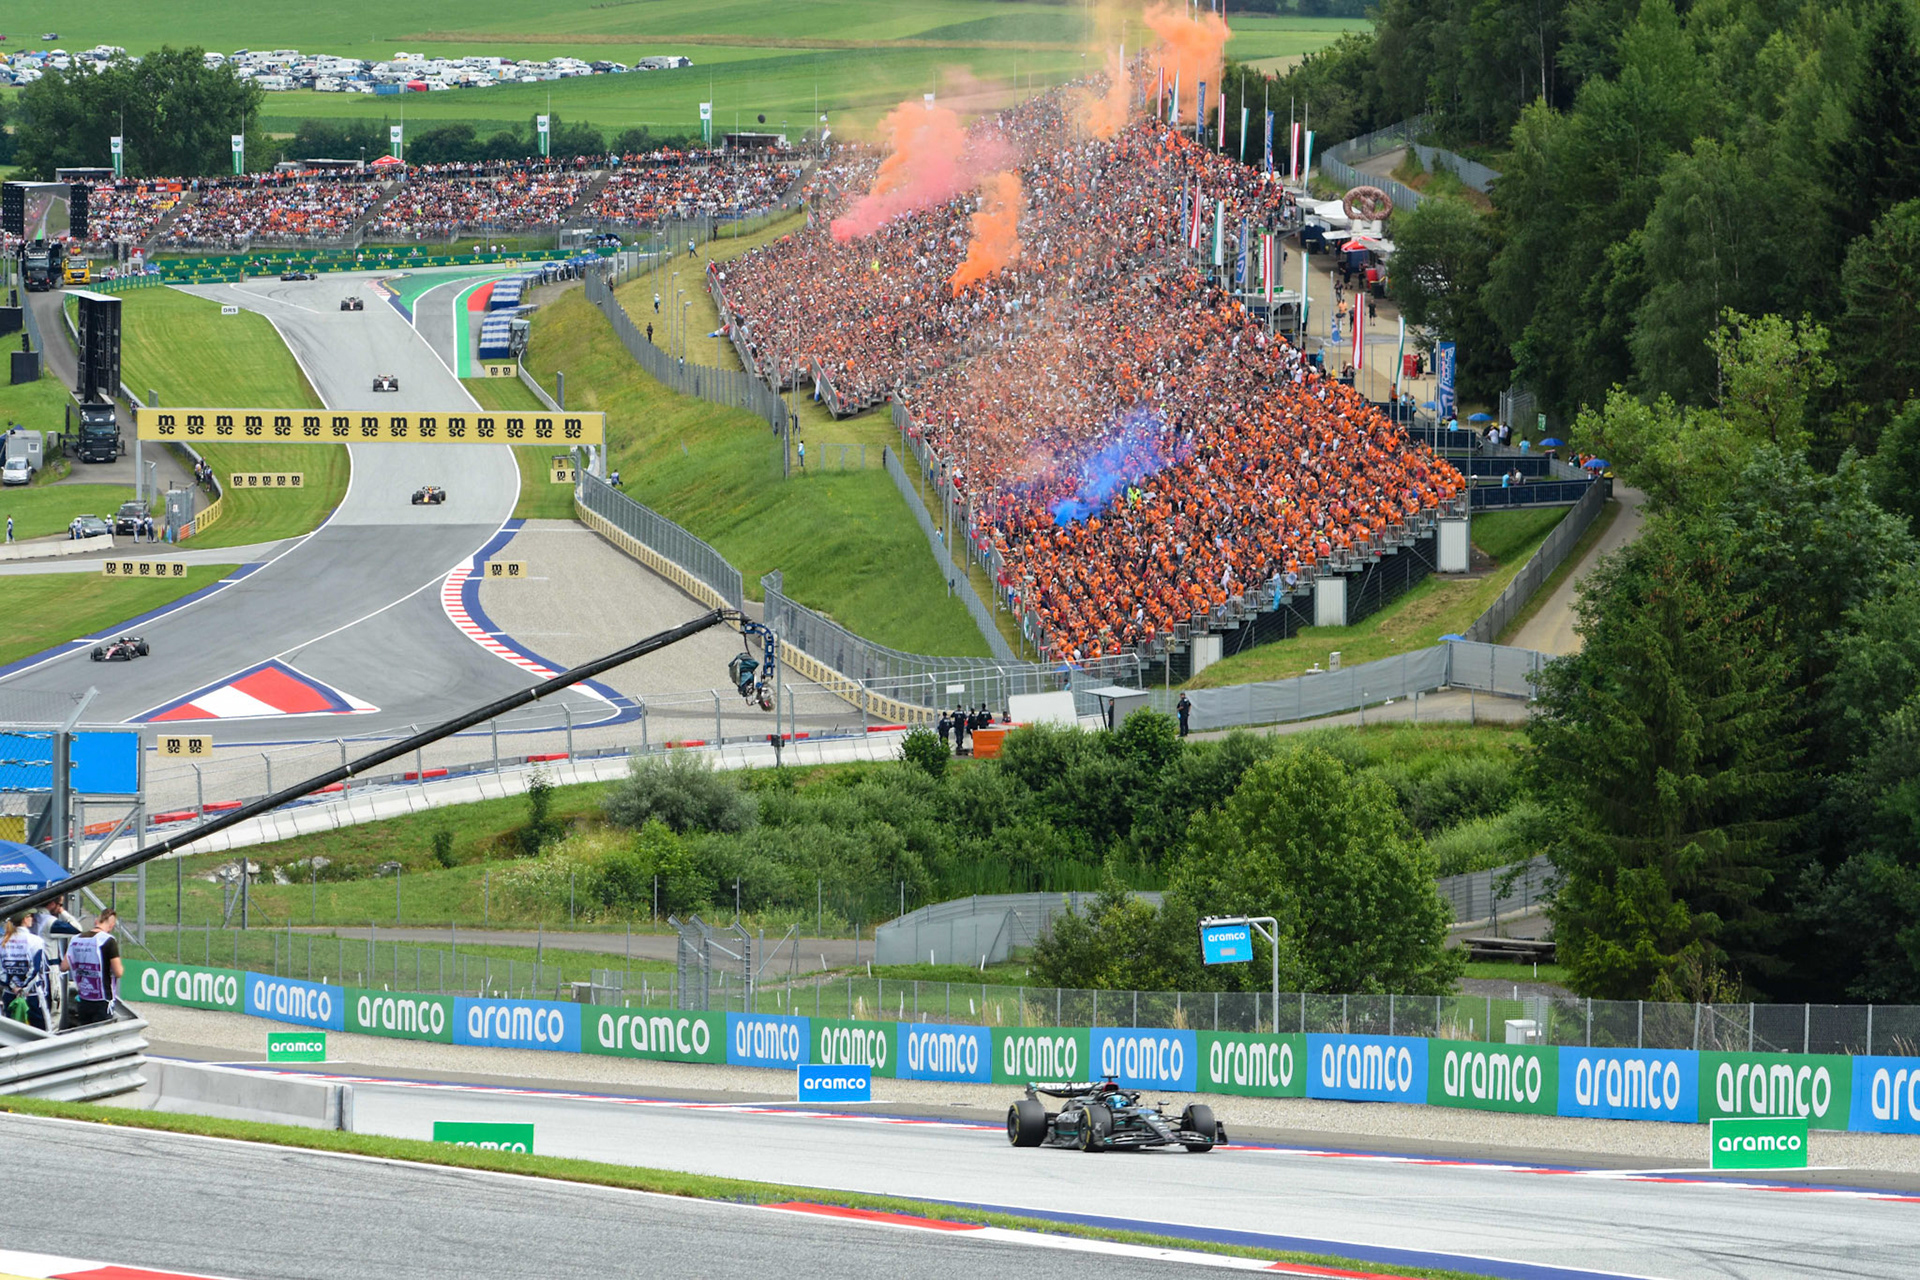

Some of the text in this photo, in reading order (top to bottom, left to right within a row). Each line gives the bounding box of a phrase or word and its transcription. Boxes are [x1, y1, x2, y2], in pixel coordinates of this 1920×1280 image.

[1208, 932, 1246, 942] aramco
[141, 967, 237, 1006] aramco
[254, 980, 332, 1021] aramco
[357, 995, 445, 1035] aramco
[468, 1005, 565, 1043] aramco
[598, 1013, 711, 1055] aramco
[271, 1042, 323, 1052] aramco
[736, 1020, 800, 1061] aramco
[821, 1027, 888, 1069] aramco
[908, 1032, 979, 1074] aramco
[1004, 1036, 1078, 1078] aramco
[1102, 1037, 1184, 1082] aramco
[804, 1078, 866, 1089] aramco
[1210, 1041, 1294, 1087] aramco
[1322, 1043, 1413, 1092] aramco
[1444, 1050, 1542, 1104] aramco
[1575, 1058, 1681, 1110] aramco
[1716, 1062, 1832, 1118] aramco
[1718, 1135, 1801, 1151] aramco
